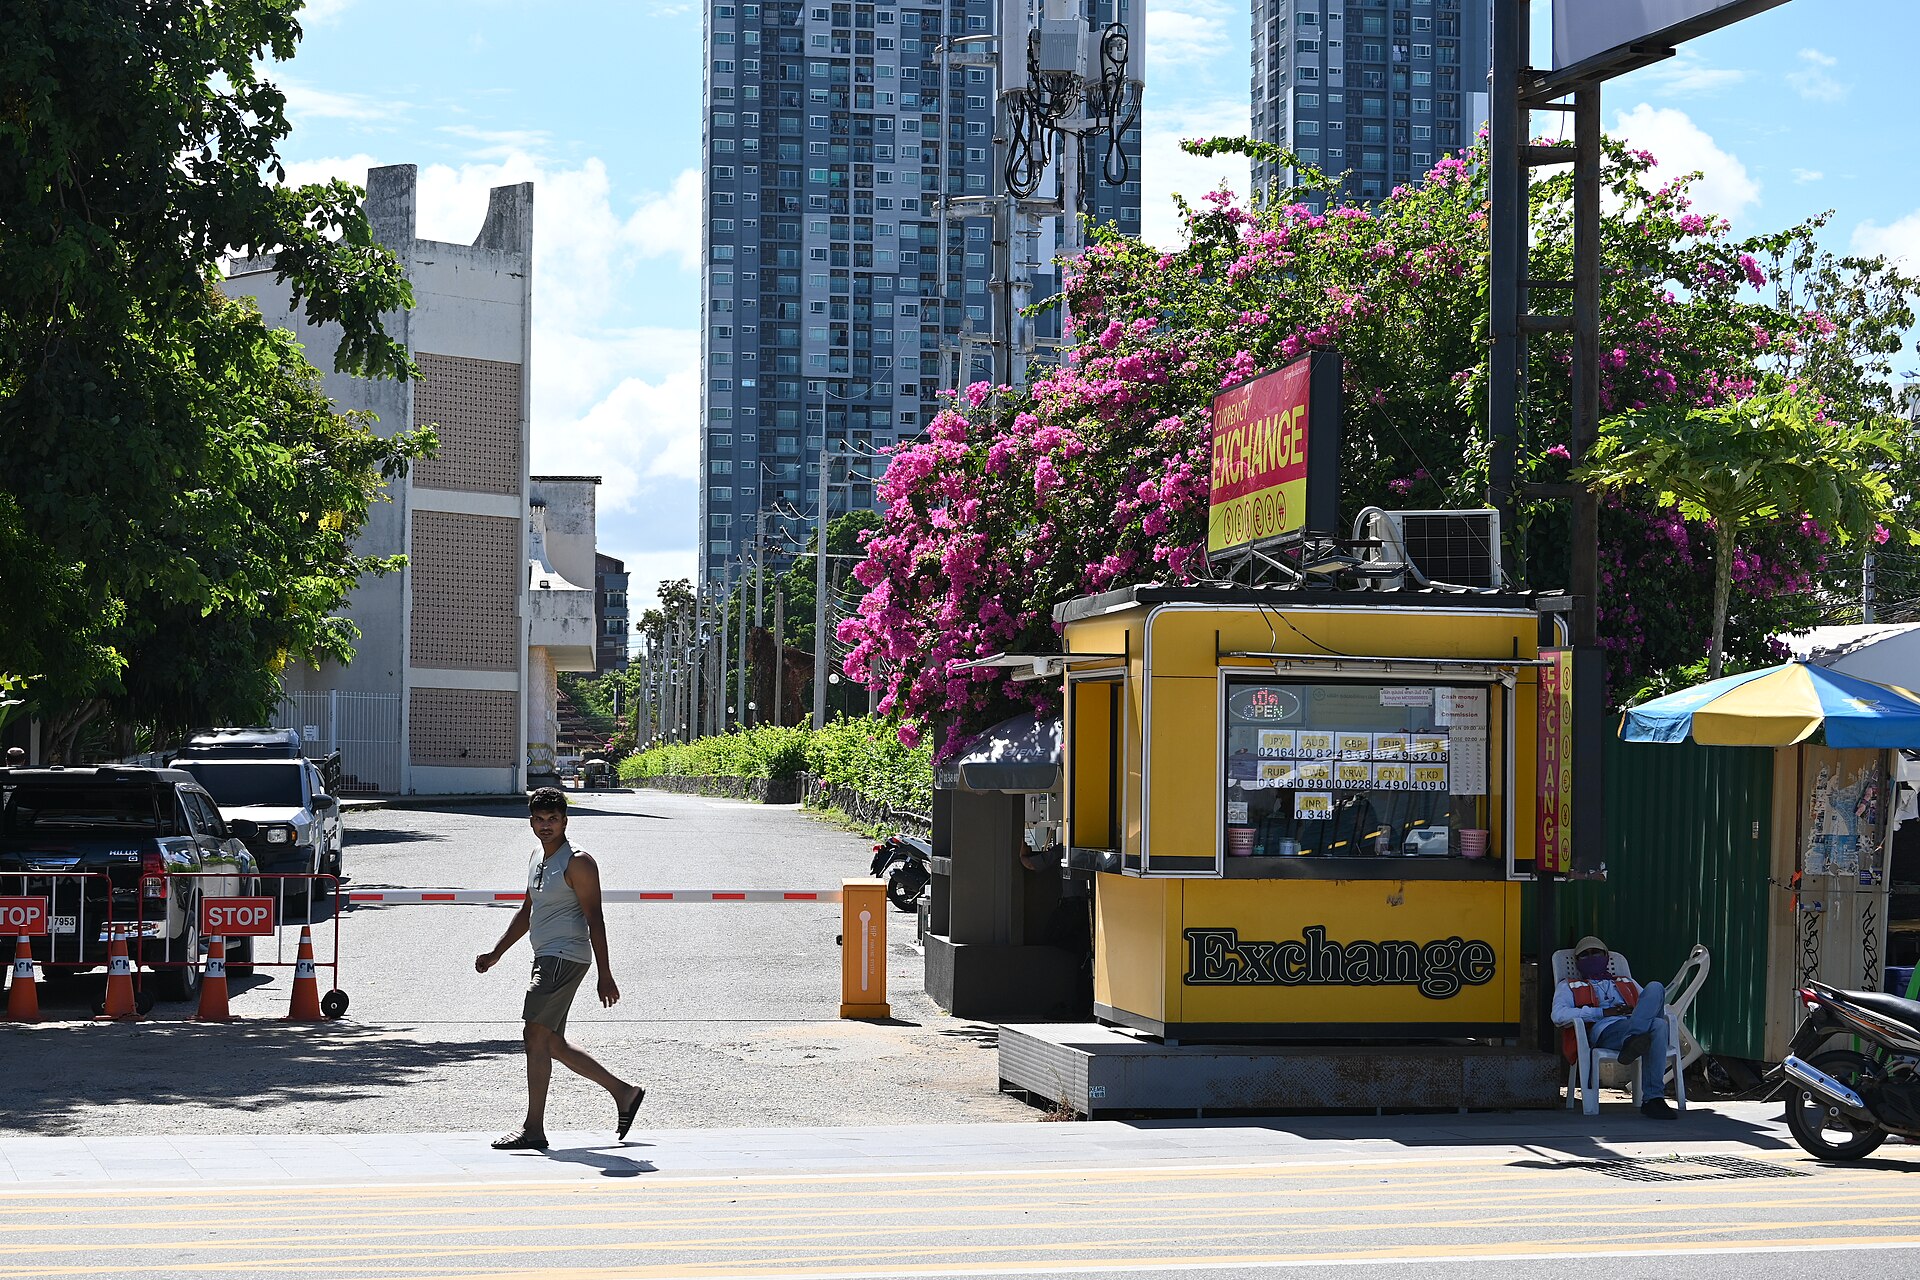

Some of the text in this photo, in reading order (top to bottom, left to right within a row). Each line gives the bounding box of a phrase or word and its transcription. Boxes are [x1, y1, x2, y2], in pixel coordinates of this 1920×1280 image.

[1215, 400, 1250, 430] CURRENCY
[1212, 404, 1305, 490] EXCHANGE
[1243, 705, 1283, 718] OPEN
[1269, 737, 1285, 746] JPY
[1305, 738, 1325, 747] AUD
[1344, 740, 1363, 748] GBP
[1383, 740, 1401, 748] EUR
[1543, 656, 1556, 868] EXCHANGE
[1267, 768, 1286, 776] RUB
[1343, 769, 1364, 778] KRW
[1382, 770, 1401, 778] CNY
[1420, 771, 1439, 779] HKD
[1296, 779, 1333, 789] 0.990
[1335, 780, 1372, 789] 0.0228
[1373, 780, 1409, 790] 4.490
[1411, 780, 1447, 790] 4.090
[1305, 799, 1321, 808] INR
[1295, 809, 1331, 819] 0.348
[0, 906, 40, 926] TOP
[208, 906, 268, 927] STOP
[54, 917, 75, 926] 7953
[1184, 926, 1496, 998] Exchange
